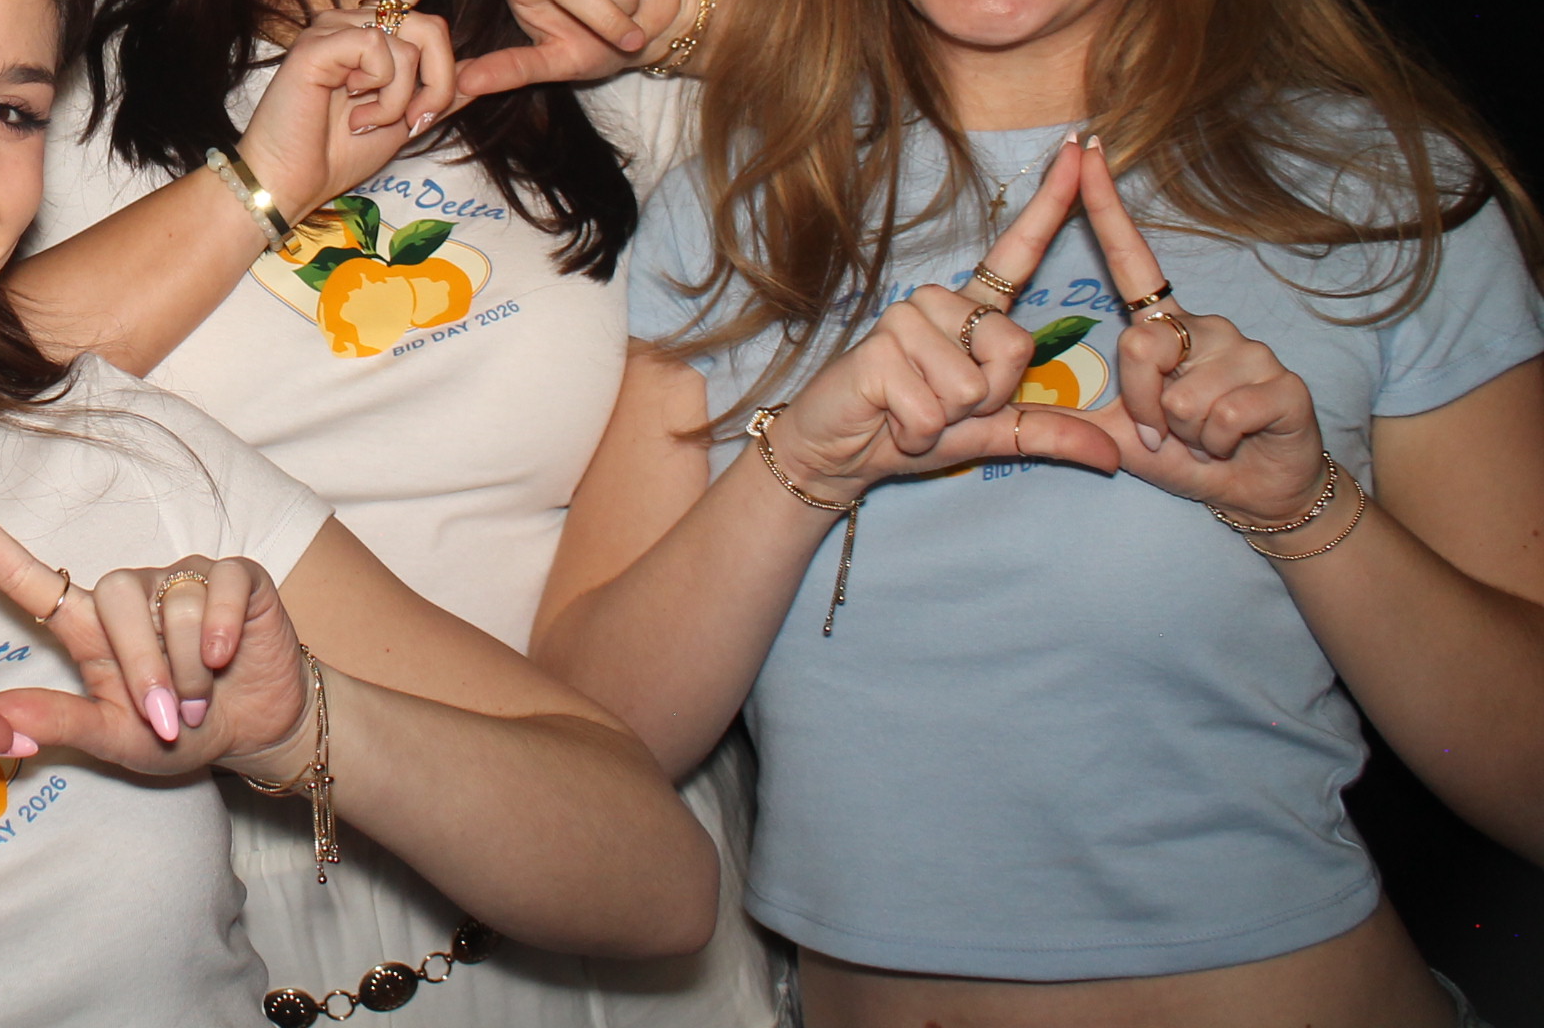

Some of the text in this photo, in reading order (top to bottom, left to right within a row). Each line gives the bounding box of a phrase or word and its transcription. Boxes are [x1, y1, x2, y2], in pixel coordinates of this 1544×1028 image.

[353, 174, 506, 220] elta Delta
[392, 299, 520, 357] BID DAY 2026
[982, 463, 1013, 481] BID
[17, 774, 67, 823] 2026
